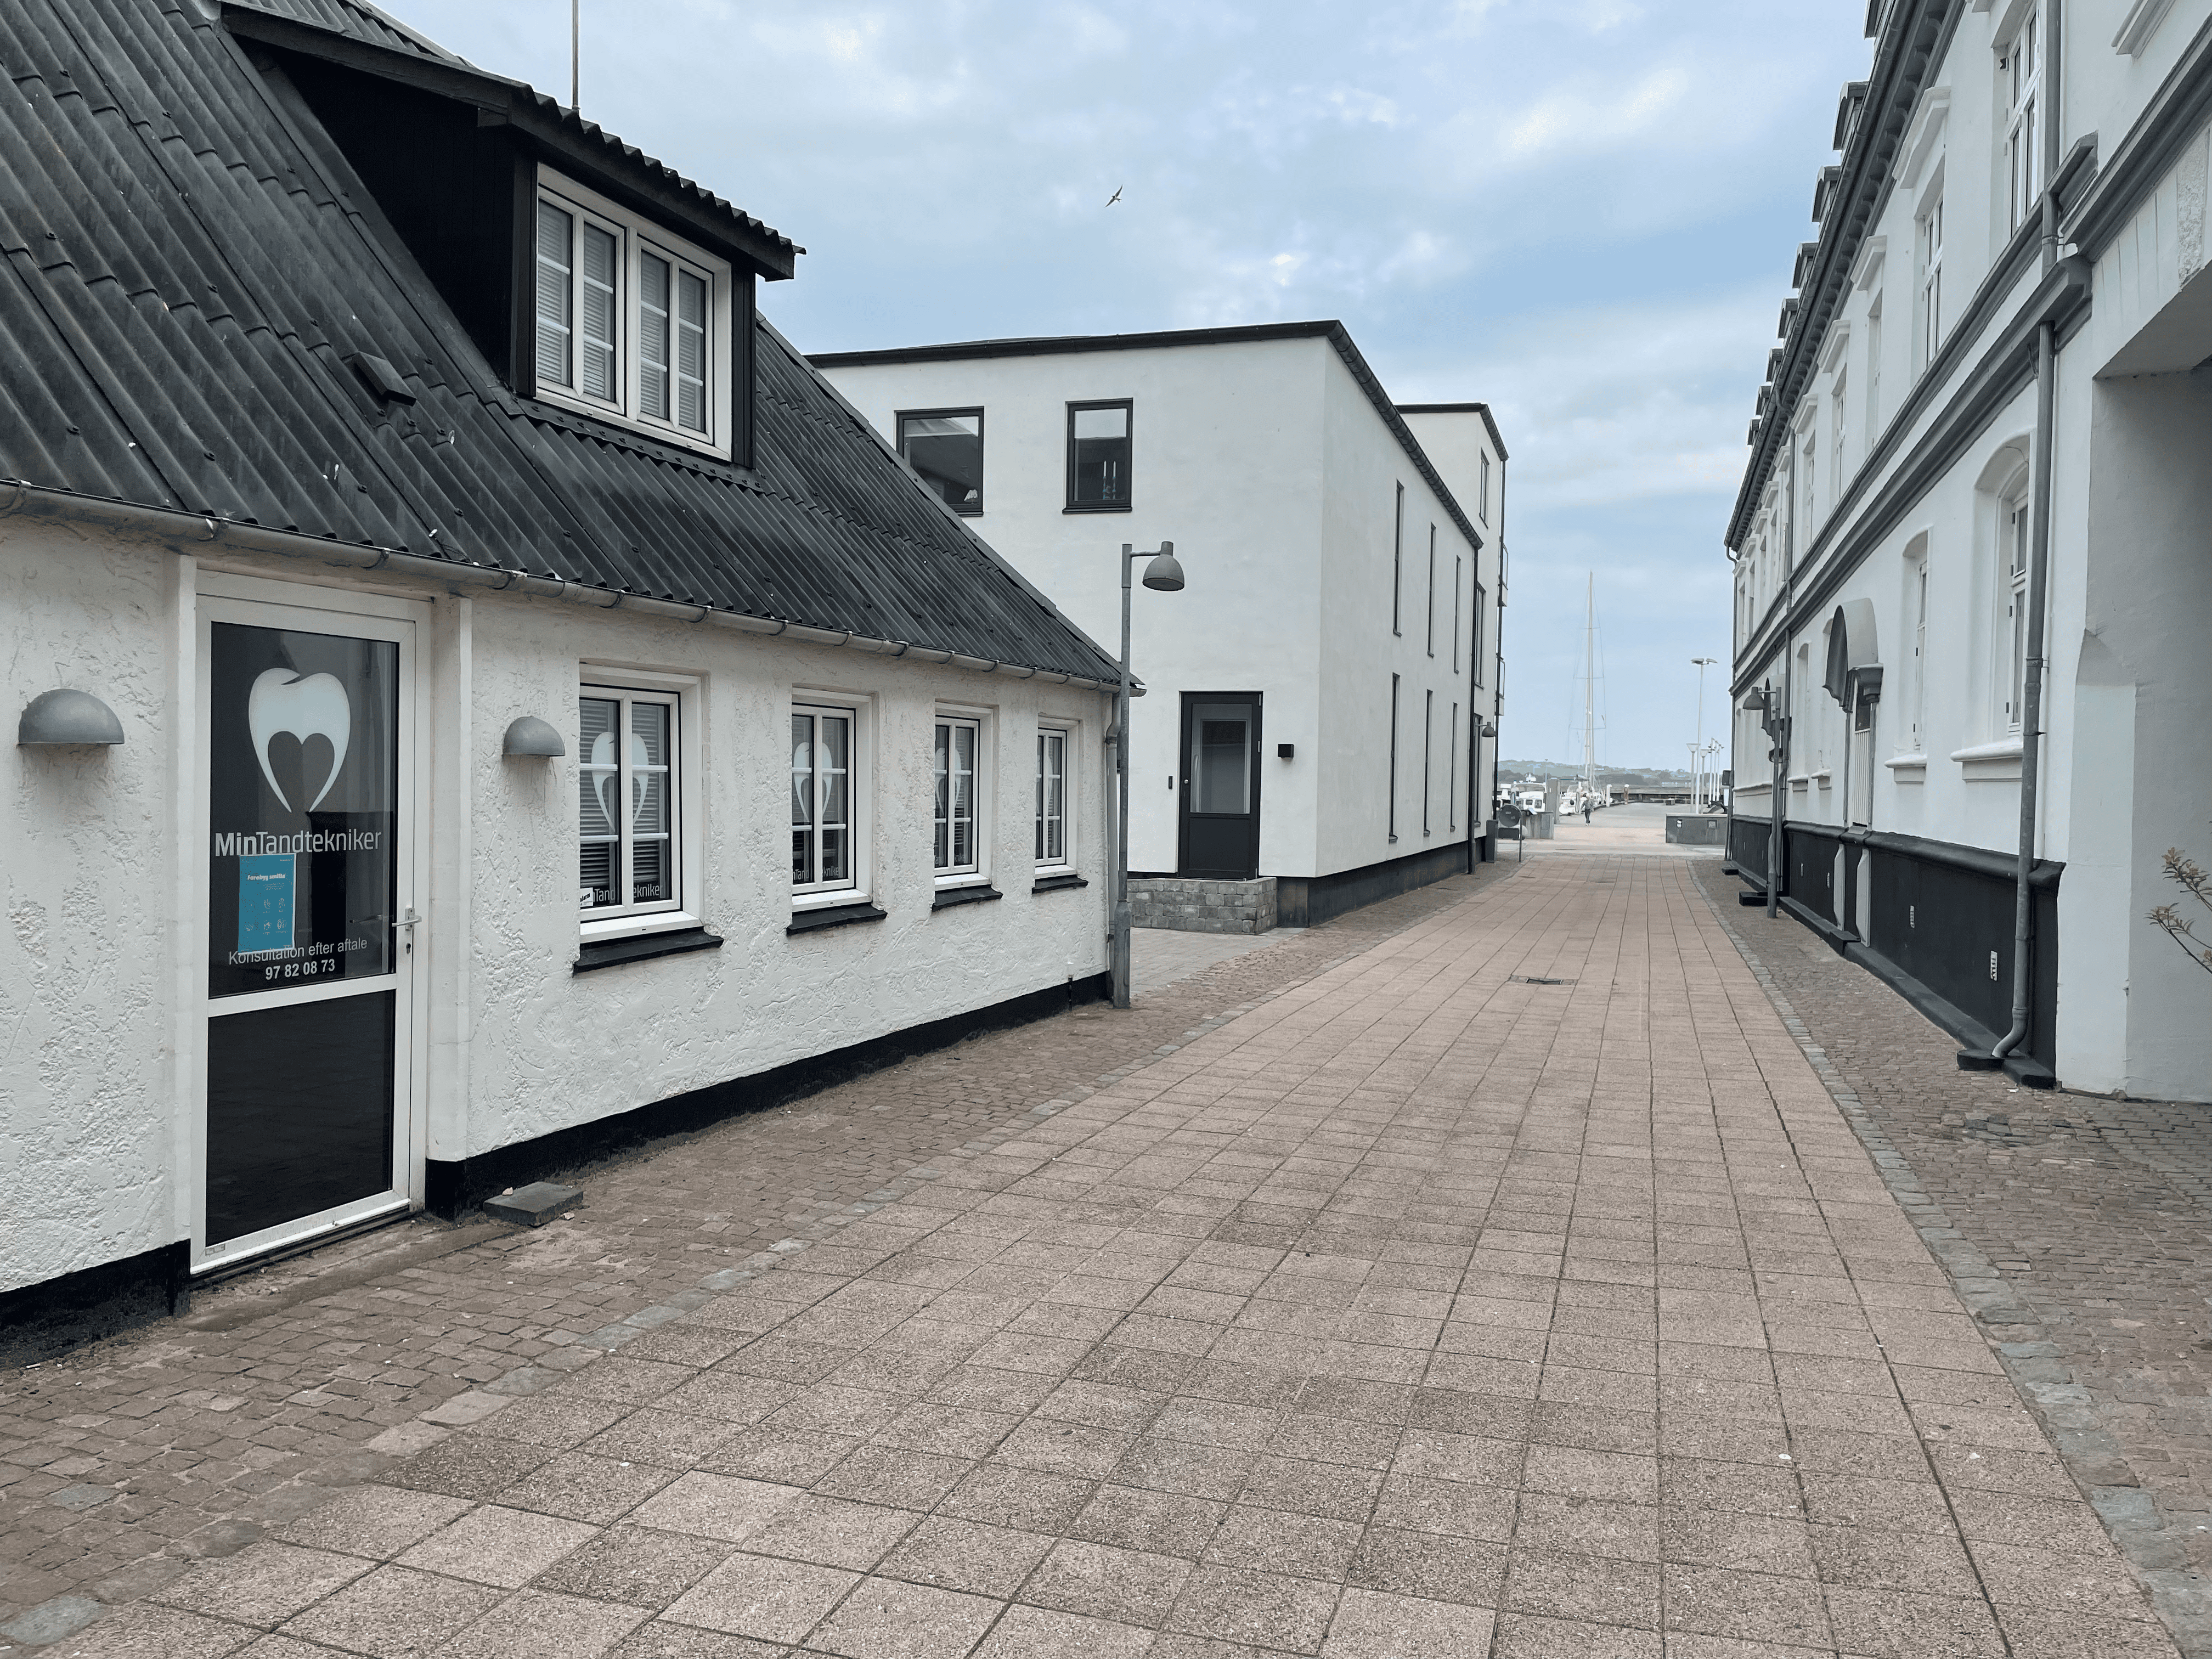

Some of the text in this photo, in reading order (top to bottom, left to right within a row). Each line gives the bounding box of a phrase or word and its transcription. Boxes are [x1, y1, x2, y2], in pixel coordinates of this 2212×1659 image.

[215, 828, 381, 856] MinTandtekniker
[229, 937, 368, 965] Konsultation efter aftale
[266, 958, 335, 980] 97 82 08 73
